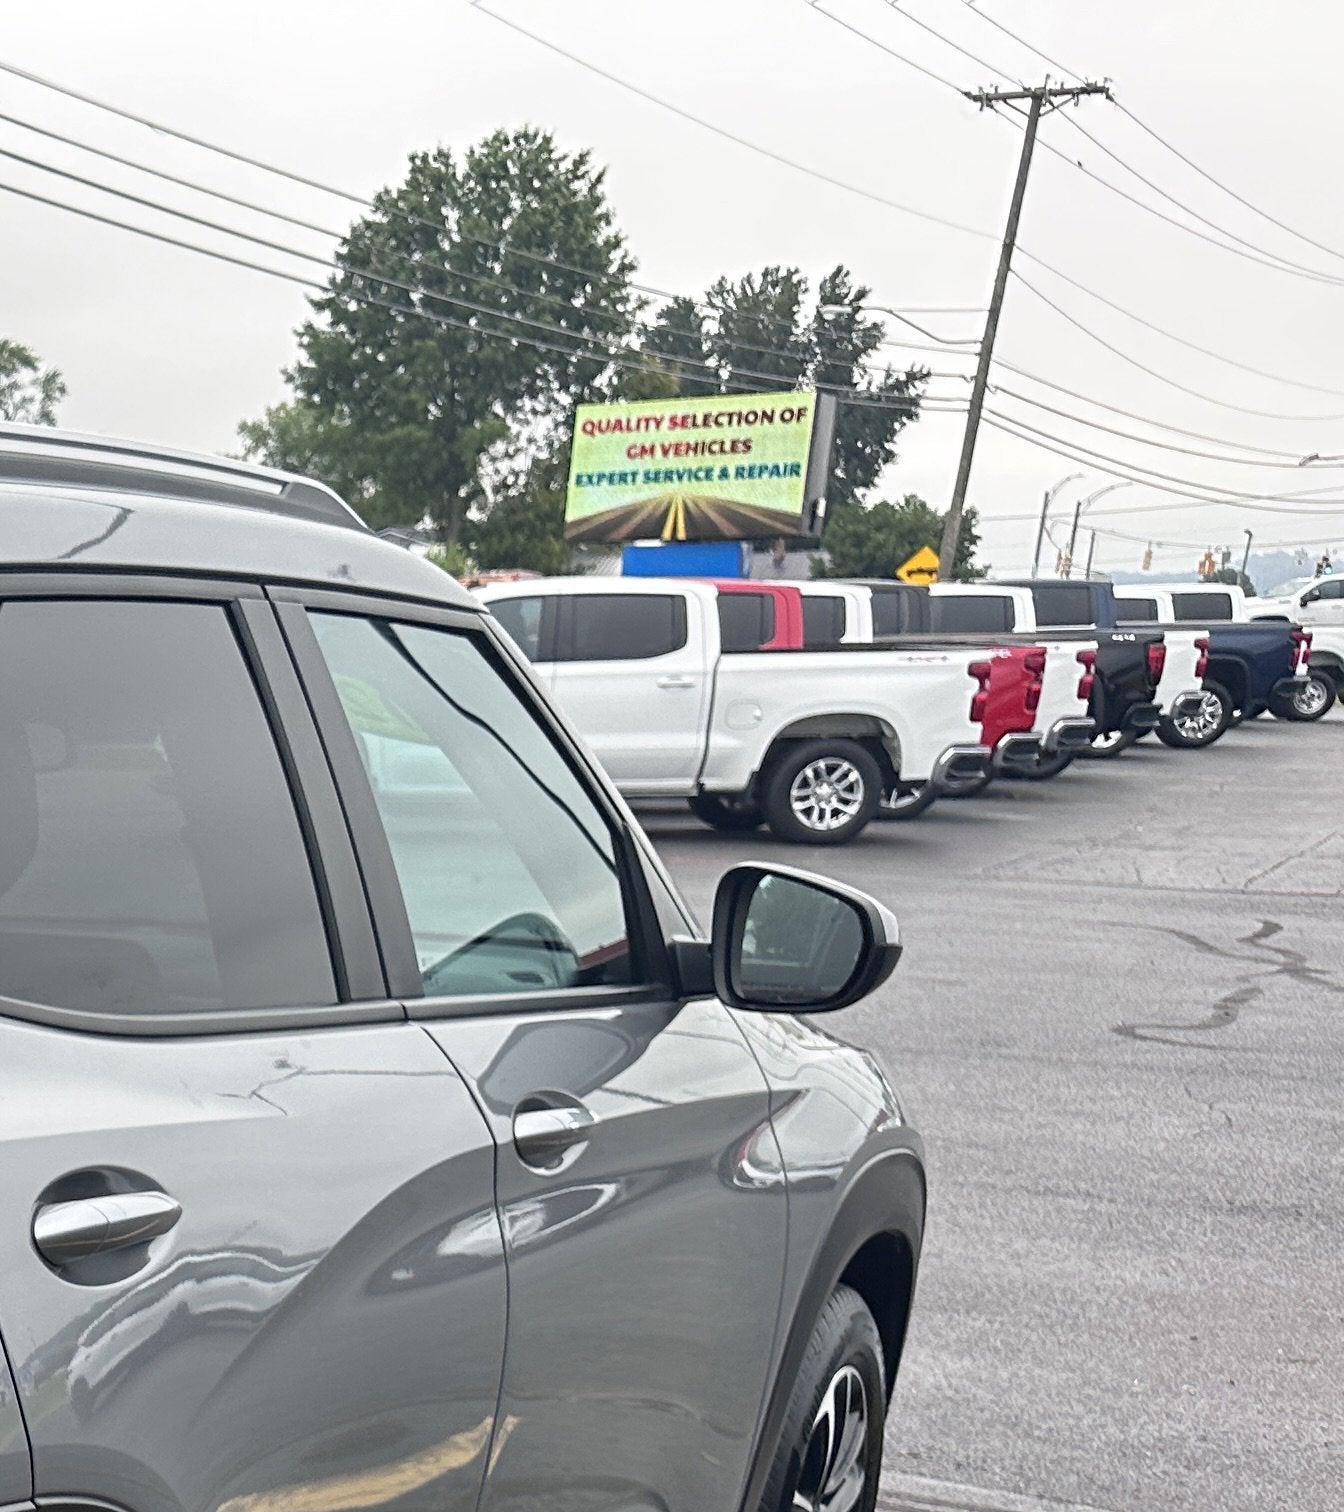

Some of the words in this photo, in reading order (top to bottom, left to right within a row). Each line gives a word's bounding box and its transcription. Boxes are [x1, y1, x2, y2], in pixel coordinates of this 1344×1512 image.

[582, 415, 664, 437] QUALITY
[668, 408, 774, 430] SELECTION
[780, 406, 807, 424] OF
[626, 443, 655, 459] GM
[660, 439, 752, 458] VEHICLES
[575, 470, 638, 487] EXPERT
[642, 466, 714, 484] SERVICE
[718, 465, 730, 480] &
[735, 461, 801, 480] REPAIR
